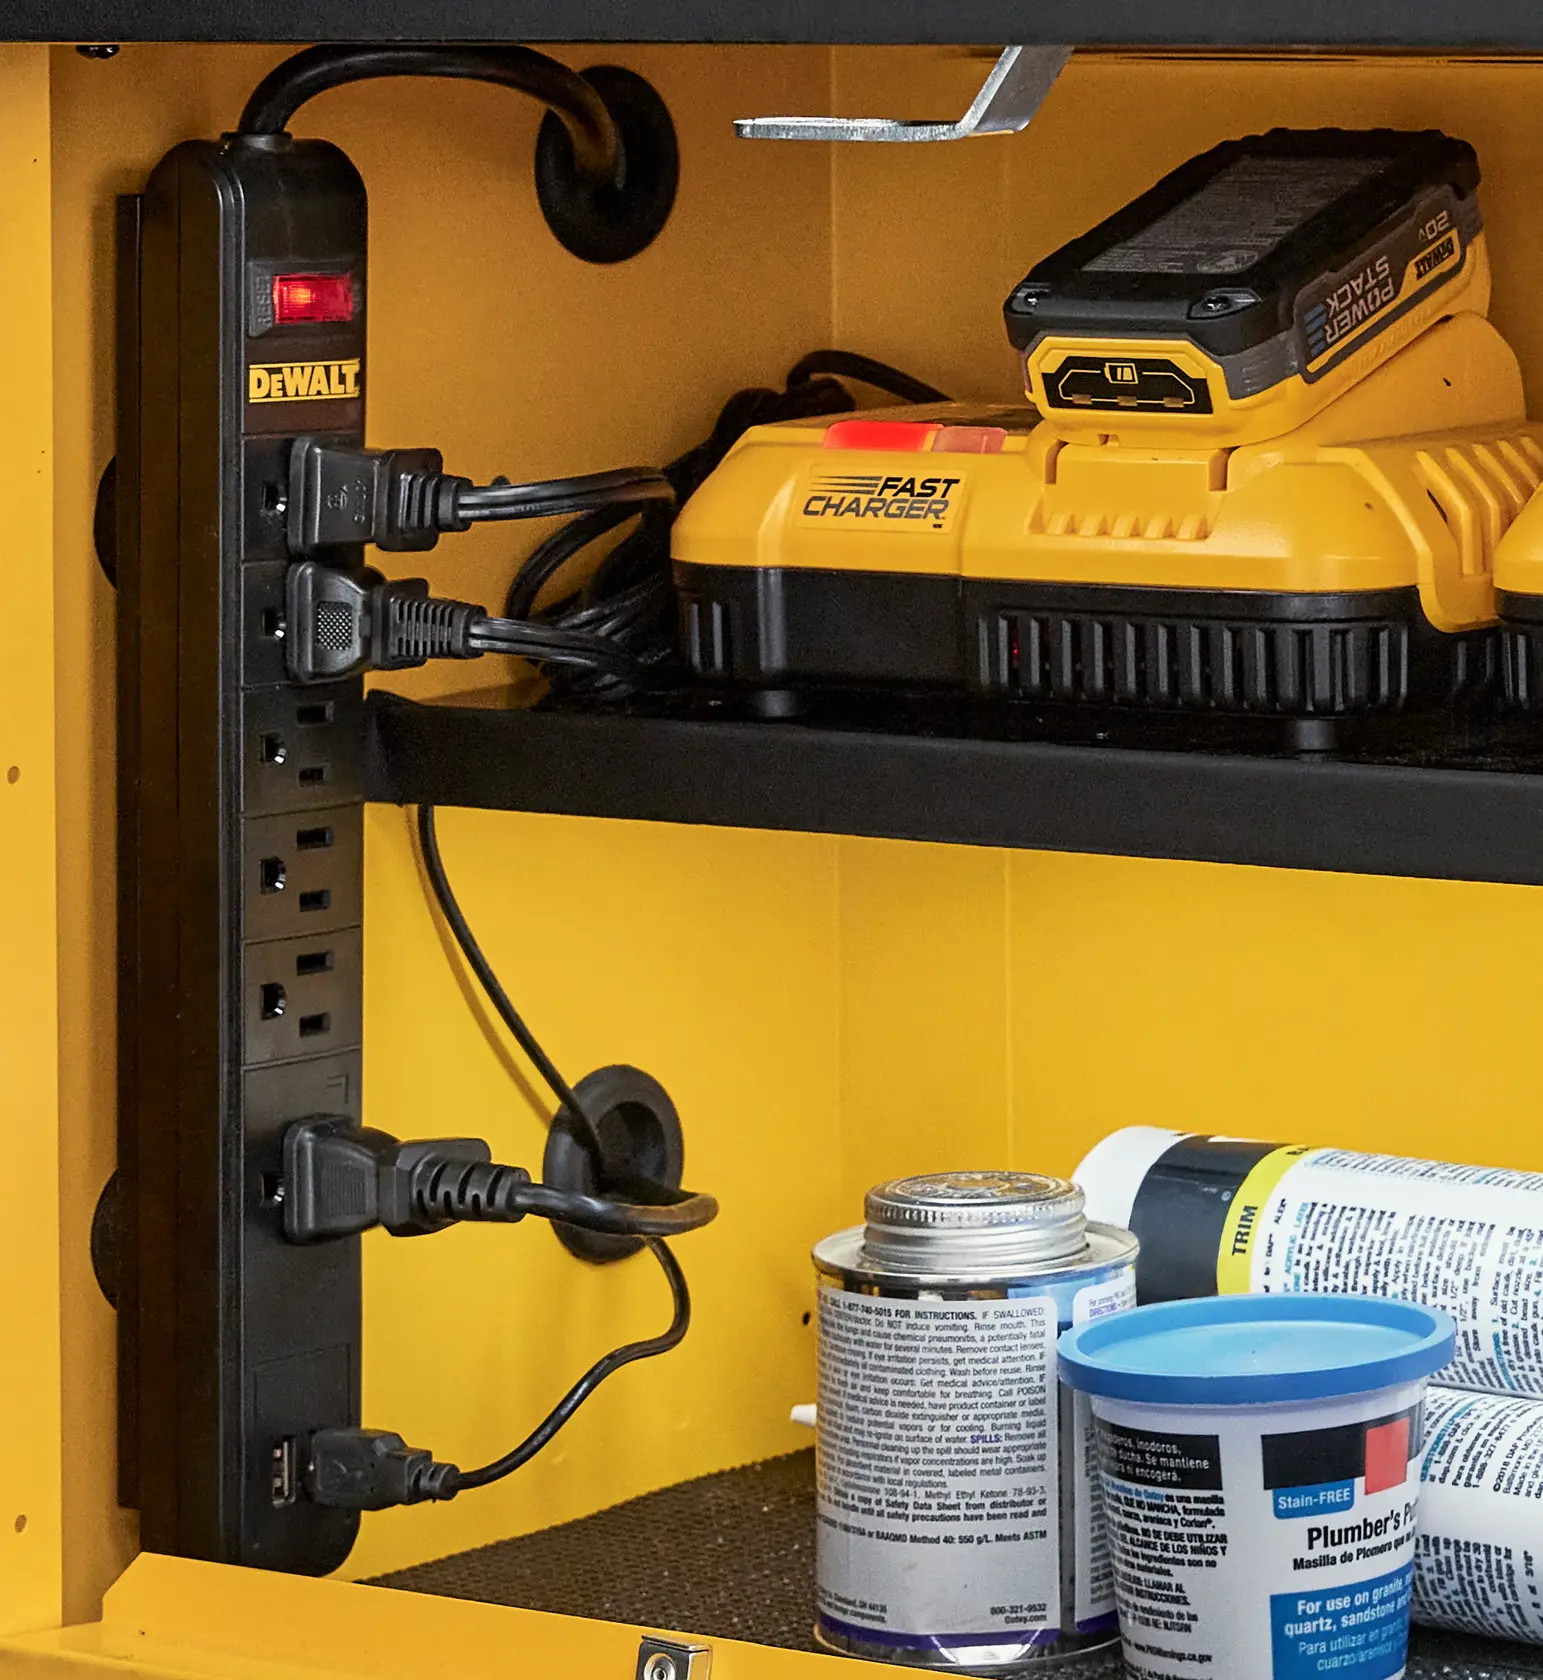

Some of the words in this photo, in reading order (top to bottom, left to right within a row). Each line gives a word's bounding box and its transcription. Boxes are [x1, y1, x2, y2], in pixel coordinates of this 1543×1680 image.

[1324, 255, 1388, 315] STACK
[1326, 272, 1394, 344] POWER
[878, 476, 960, 498] FAST
[803, 496, 949, 520] CHARGER
[1232, 1205, 1258, 1256] TRIM
[1490, 1271, 1501, 1306] Surface
[895, 1308, 910, 1319] FOR
[914, 1310, 977, 1320] INSTRUCTIONS.
[988, 1332, 1027, 1343] potentially
[956, 1345, 988, 1354] Remove
[990, 1344, 1018, 1352] contact
[968, 1356, 1000, 1364] medical
[972, 1368, 998, 1376] before
[937, 1380, 968, 1388] medical
[1016, 1384, 1046, 1396] POISON
[928, 1402, 947, 1410] have
[948, 1402, 978, 1411] product
[980, 1400, 1017, 1410] container
[912, 1412, 958, 1422] extinguisher
[973, 1410, 1018, 1421] appropriate
[970, 1434, 1002, 1444] SPILLS:
[954, 1446, 980, 1454] should
[1136, 1438, 1182, 1455] inodoros,
[922, 1458, 980, 1466] concentrations
[1146, 1453, 1157, 1465] Se
[1160, 1457, 1210, 1469] mantiene
[1451, 1464, 1466, 1487] Para
[1513, 1471, 1528, 1496] Made
[956, 1490, 976, 1500] Ethyl
[980, 1490, 1008, 1499] Ketone
[1278, 1488, 1350, 1510] Stain-FREE
[912, 1501, 932, 1510] Data
[936, 1502, 961, 1511] Sheet
[965, 1502, 986, 1510] from
[990, 1499, 1034, 1510] distributor
[912, 1514, 961, 1523] precautions
[963, 1512, 984, 1522] have
[986, 1512, 1008, 1521] been
[1010, 1509, 1029, 1520] read
[1031, 1508, 1047, 1518] and
[1307, 1509, 1400, 1550] Plumber's
[910, 1534, 940, 1544] Method
[958, 1534, 974, 1544] 550
[994, 1532, 1020, 1542] Meets
[1023, 1530, 1047, 1540] ASTM
[1163, 1531, 1186, 1542] DEBE
[1186, 1532, 1228, 1544] UTILIZAR
[1172, 1543, 1188, 1554] LOS
[1190, 1542, 1218, 1556] NIÑOS
[1293, 1554, 1336, 1571] Masilla
[1340, 1550, 1353, 1564] de
[1356, 1541, 1392, 1560] Plomero
[1297, 1600, 1322, 1616] For
[1326, 1596, 1350, 1612] use
[1354, 1592, 1370, 1605] on
[1284, 1618, 1338, 1638] quartz,
[1340, 1600, 1395, 1628] sandstone
[1299, 1641, 1327, 1656] Para
[1330, 1632, 1367, 1651] utilizar
